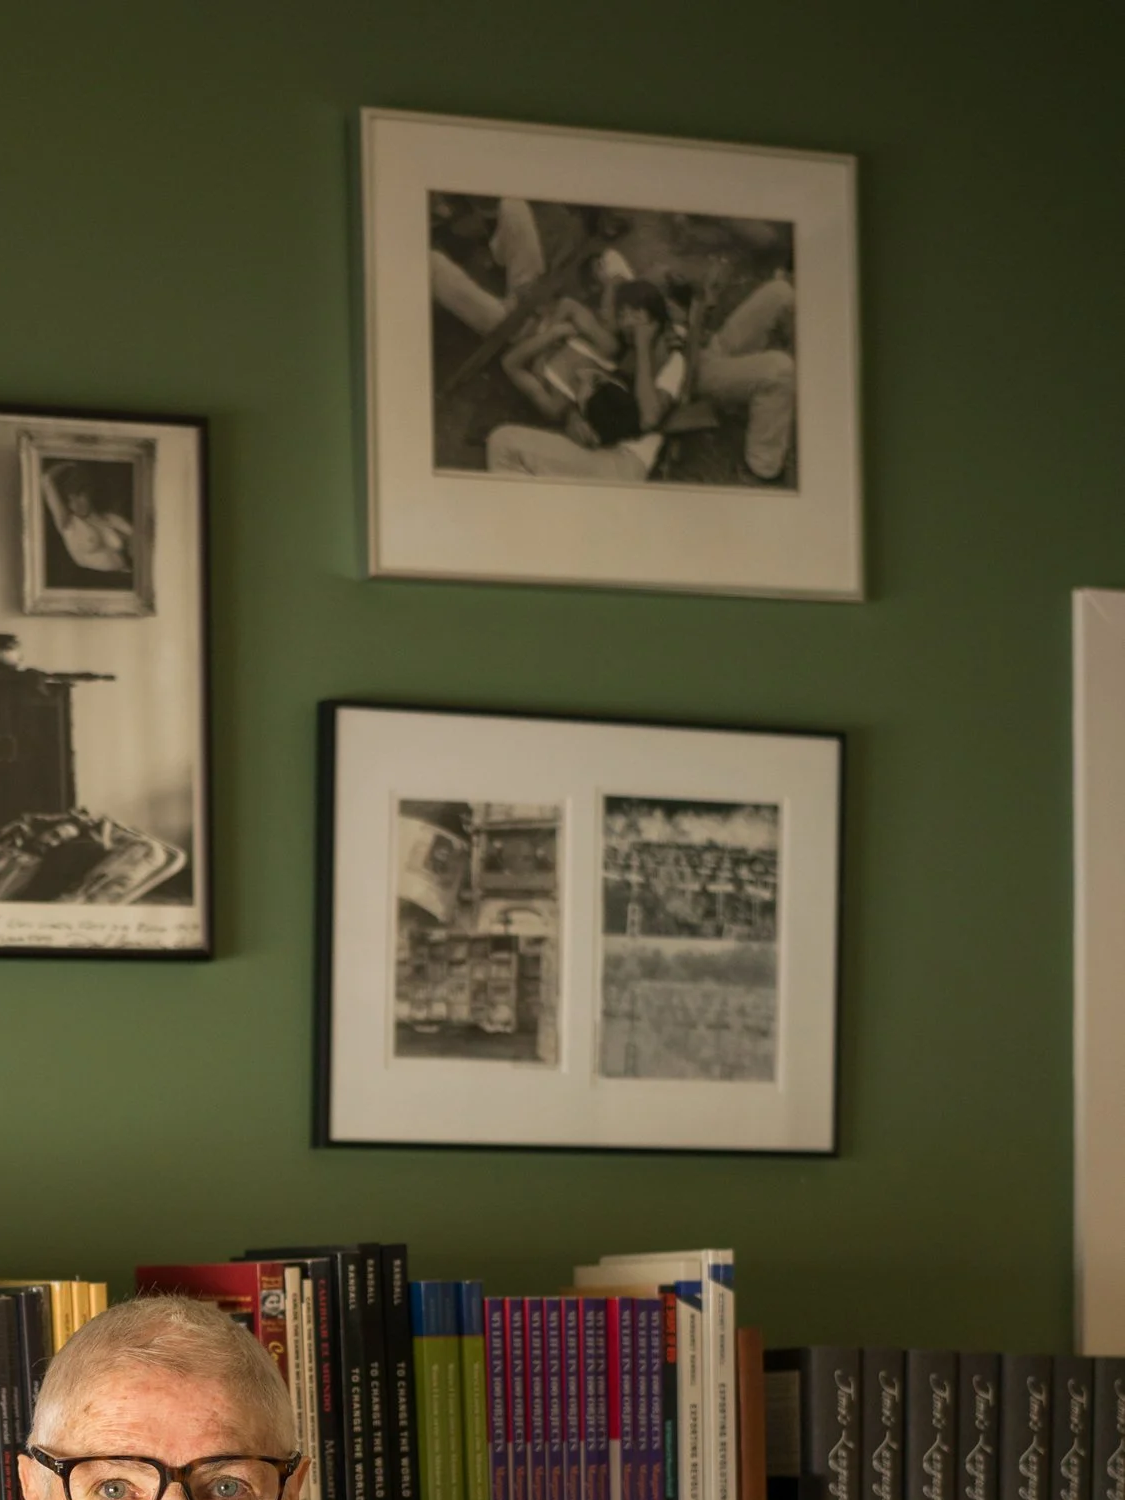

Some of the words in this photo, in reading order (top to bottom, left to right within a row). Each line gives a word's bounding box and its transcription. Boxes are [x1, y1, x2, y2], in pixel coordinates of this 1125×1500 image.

[347, 1262, 356, 1311] RANDALL
[350, 1366, 360, 1382] TO
[351, 1384, 361, 1431] CHANGE
[352, 1437, 363, 1457] THE
